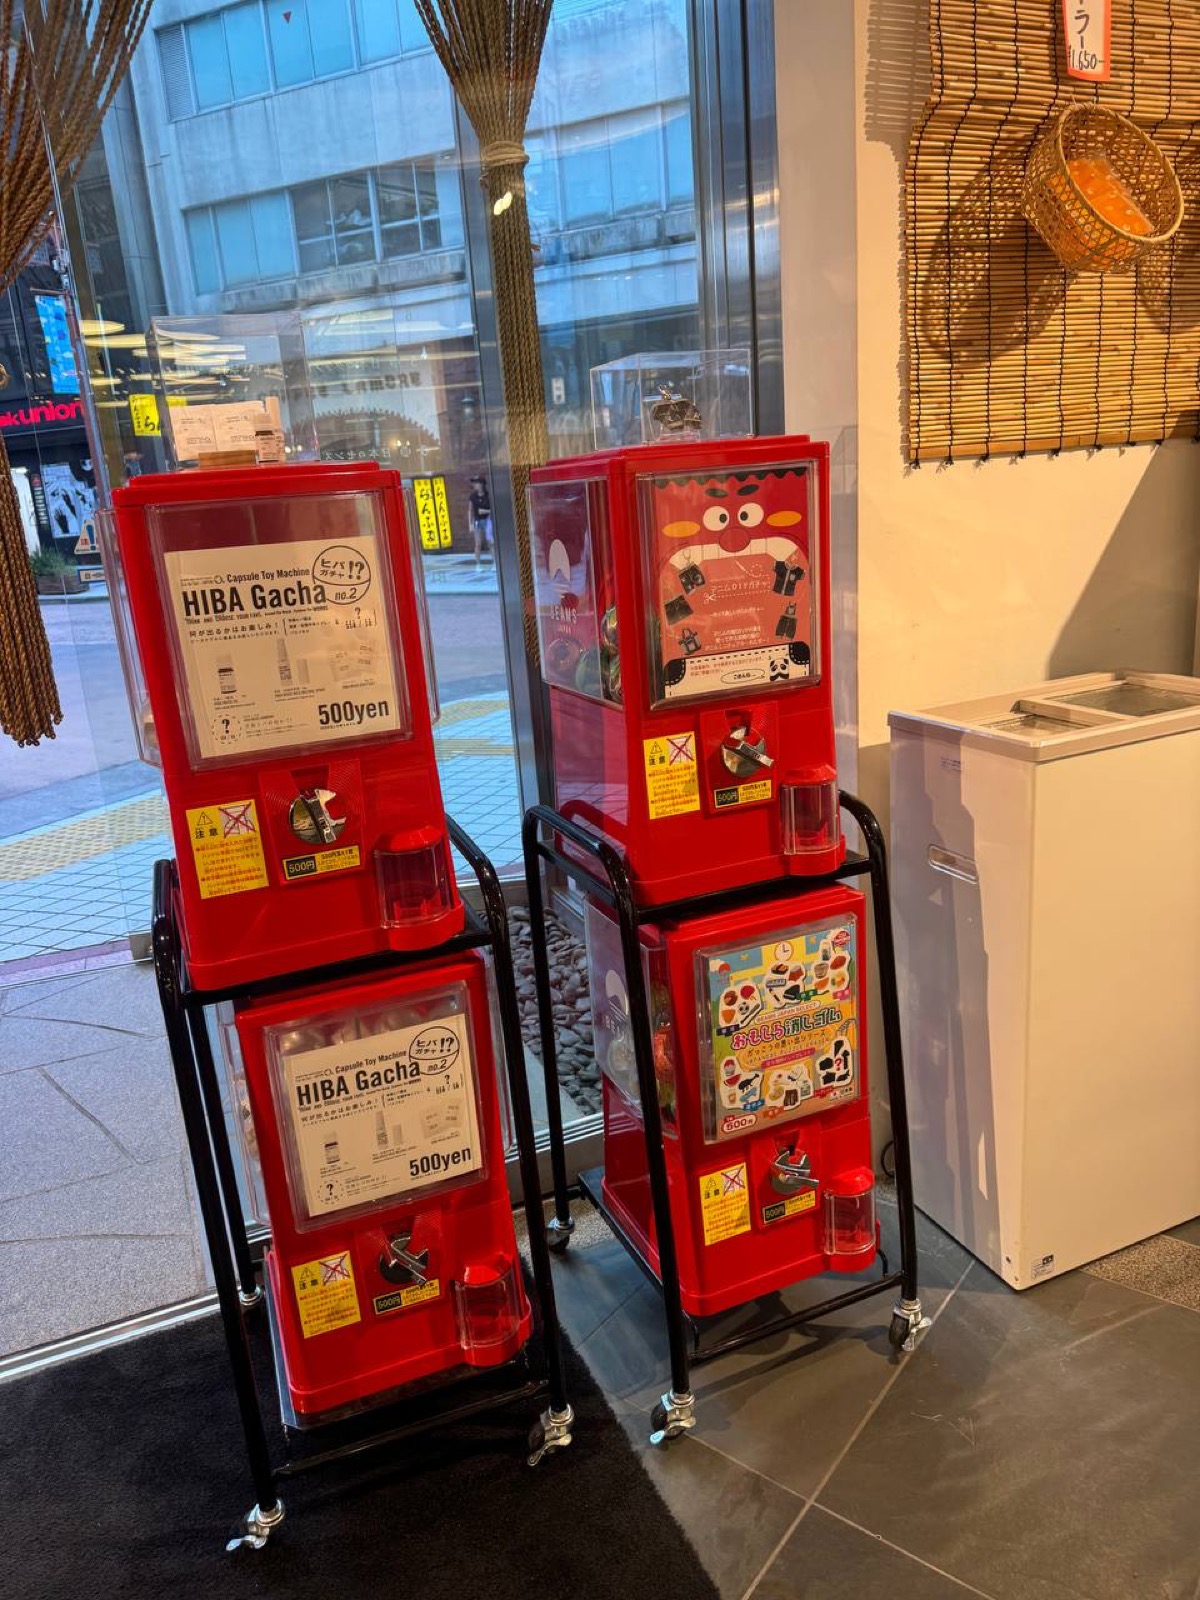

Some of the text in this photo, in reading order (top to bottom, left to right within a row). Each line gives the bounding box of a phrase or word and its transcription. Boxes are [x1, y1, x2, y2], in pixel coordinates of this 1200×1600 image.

[1074, 0, 1090, 49] ラー
[226, 572, 260, 583] Capsule
[261, 571, 275, 581] Toy
[276, 568, 311, 580] Machine
[320, 558, 345, 569] ヒバ
[182, 586, 245, 617] HIBA
[251, 580, 327, 610] Gacha
[318, 700, 390, 726] 500yen
[289, 860, 315, 873] 500円
[416, 1039, 438, 1047] ヒバ
[334, 1050, 407, 1074] Capsule Toy Machine
[296, 1075, 349, 1106] HIBA
[355, 1060, 421, 1091] Gacha
[409, 1147, 473, 1177] 500yen
